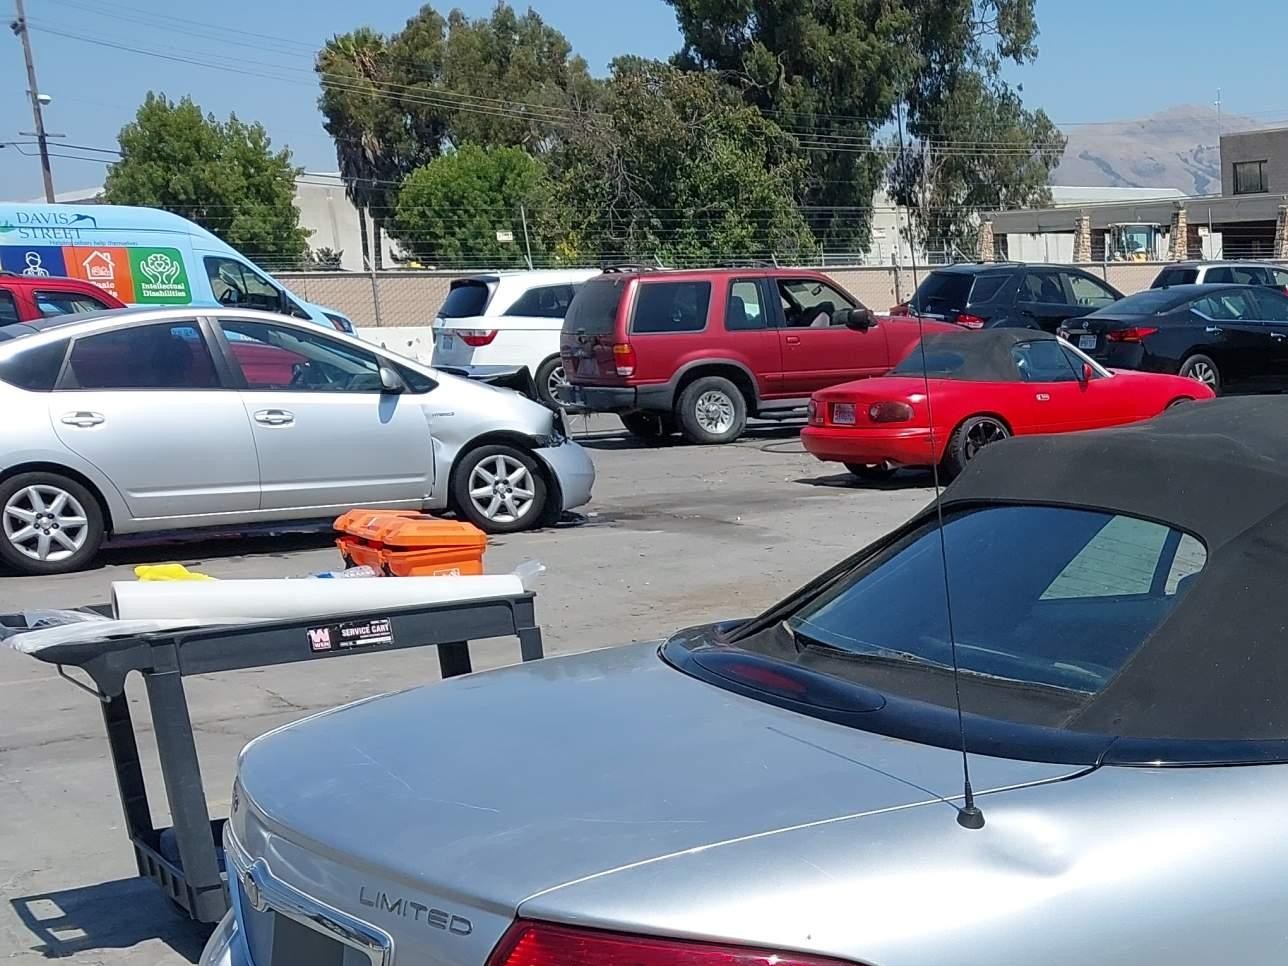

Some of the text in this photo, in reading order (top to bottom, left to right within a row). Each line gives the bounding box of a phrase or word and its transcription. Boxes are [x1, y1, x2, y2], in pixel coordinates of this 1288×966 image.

[16, 212, 69, 225] DAVIS
[19, 228, 81, 240] STREET
[143, 289, 186, 297] Disabilities
[341, 626, 371, 637] SERVICE
[371, 624, 389, 633] CART
[359, 886, 473, 936] LIMITED
